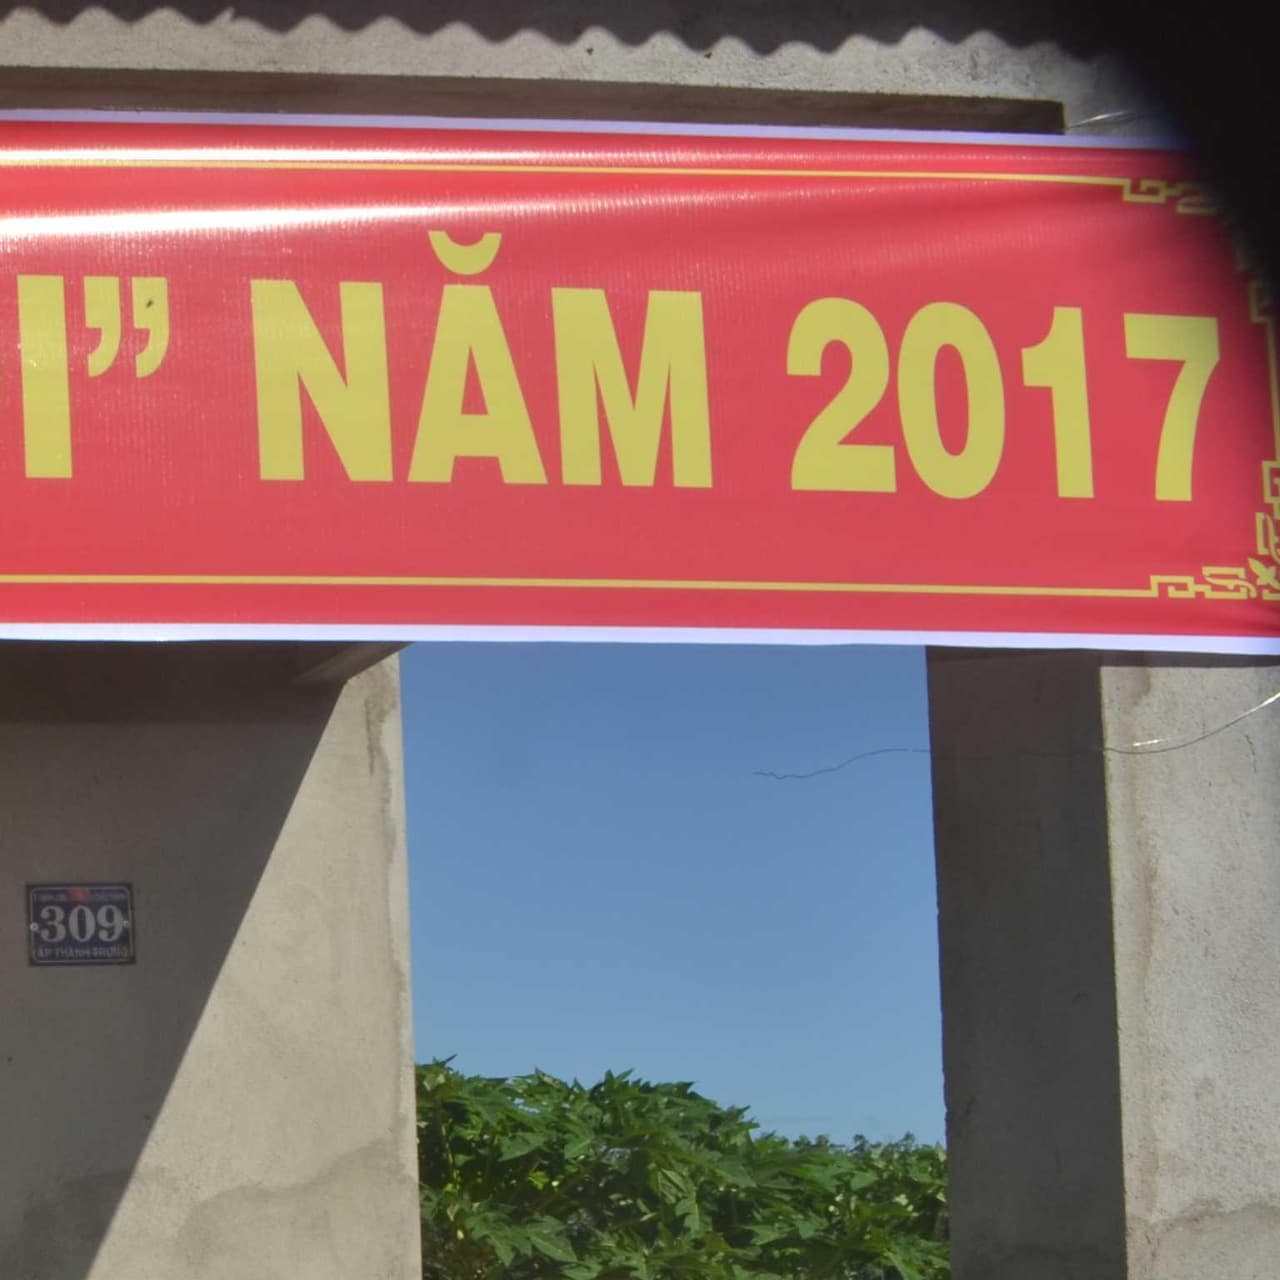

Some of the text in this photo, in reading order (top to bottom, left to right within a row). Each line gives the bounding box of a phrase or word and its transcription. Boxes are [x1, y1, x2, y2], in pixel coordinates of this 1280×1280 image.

[251, 231, 713, 488] NĂM
[786, 297, 1220, 502] 2017
[40, 904, 123, 942] 309
